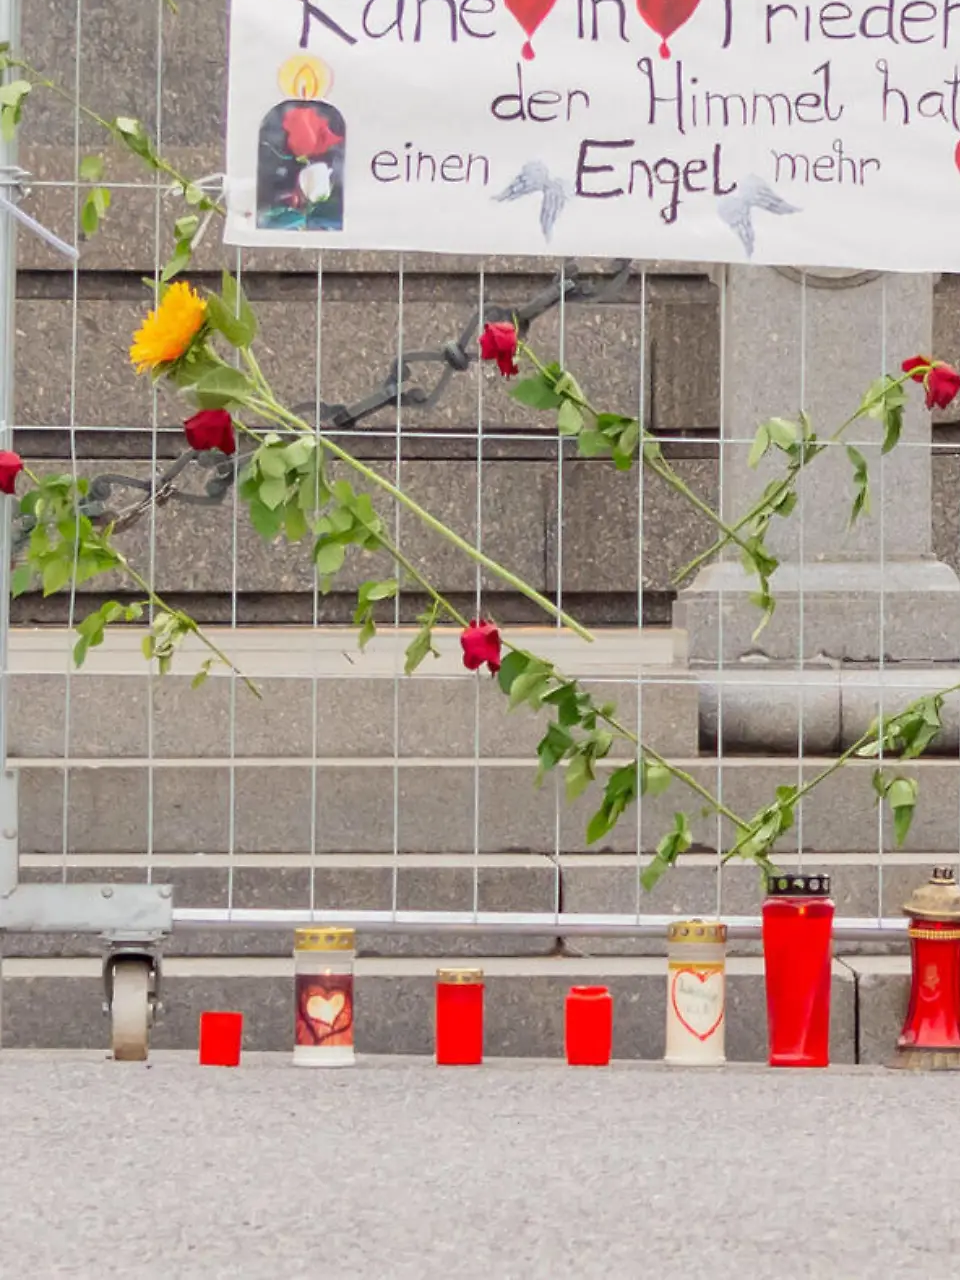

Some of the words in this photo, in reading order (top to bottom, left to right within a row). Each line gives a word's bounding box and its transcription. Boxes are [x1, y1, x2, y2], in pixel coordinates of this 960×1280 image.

[490, 61, 591, 123] der
[635, 56, 845, 136] Himmel
[370, 141, 491, 186] einen
[574, 139, 738, 225] Engel
[770, 138, 881, 187] mehr
